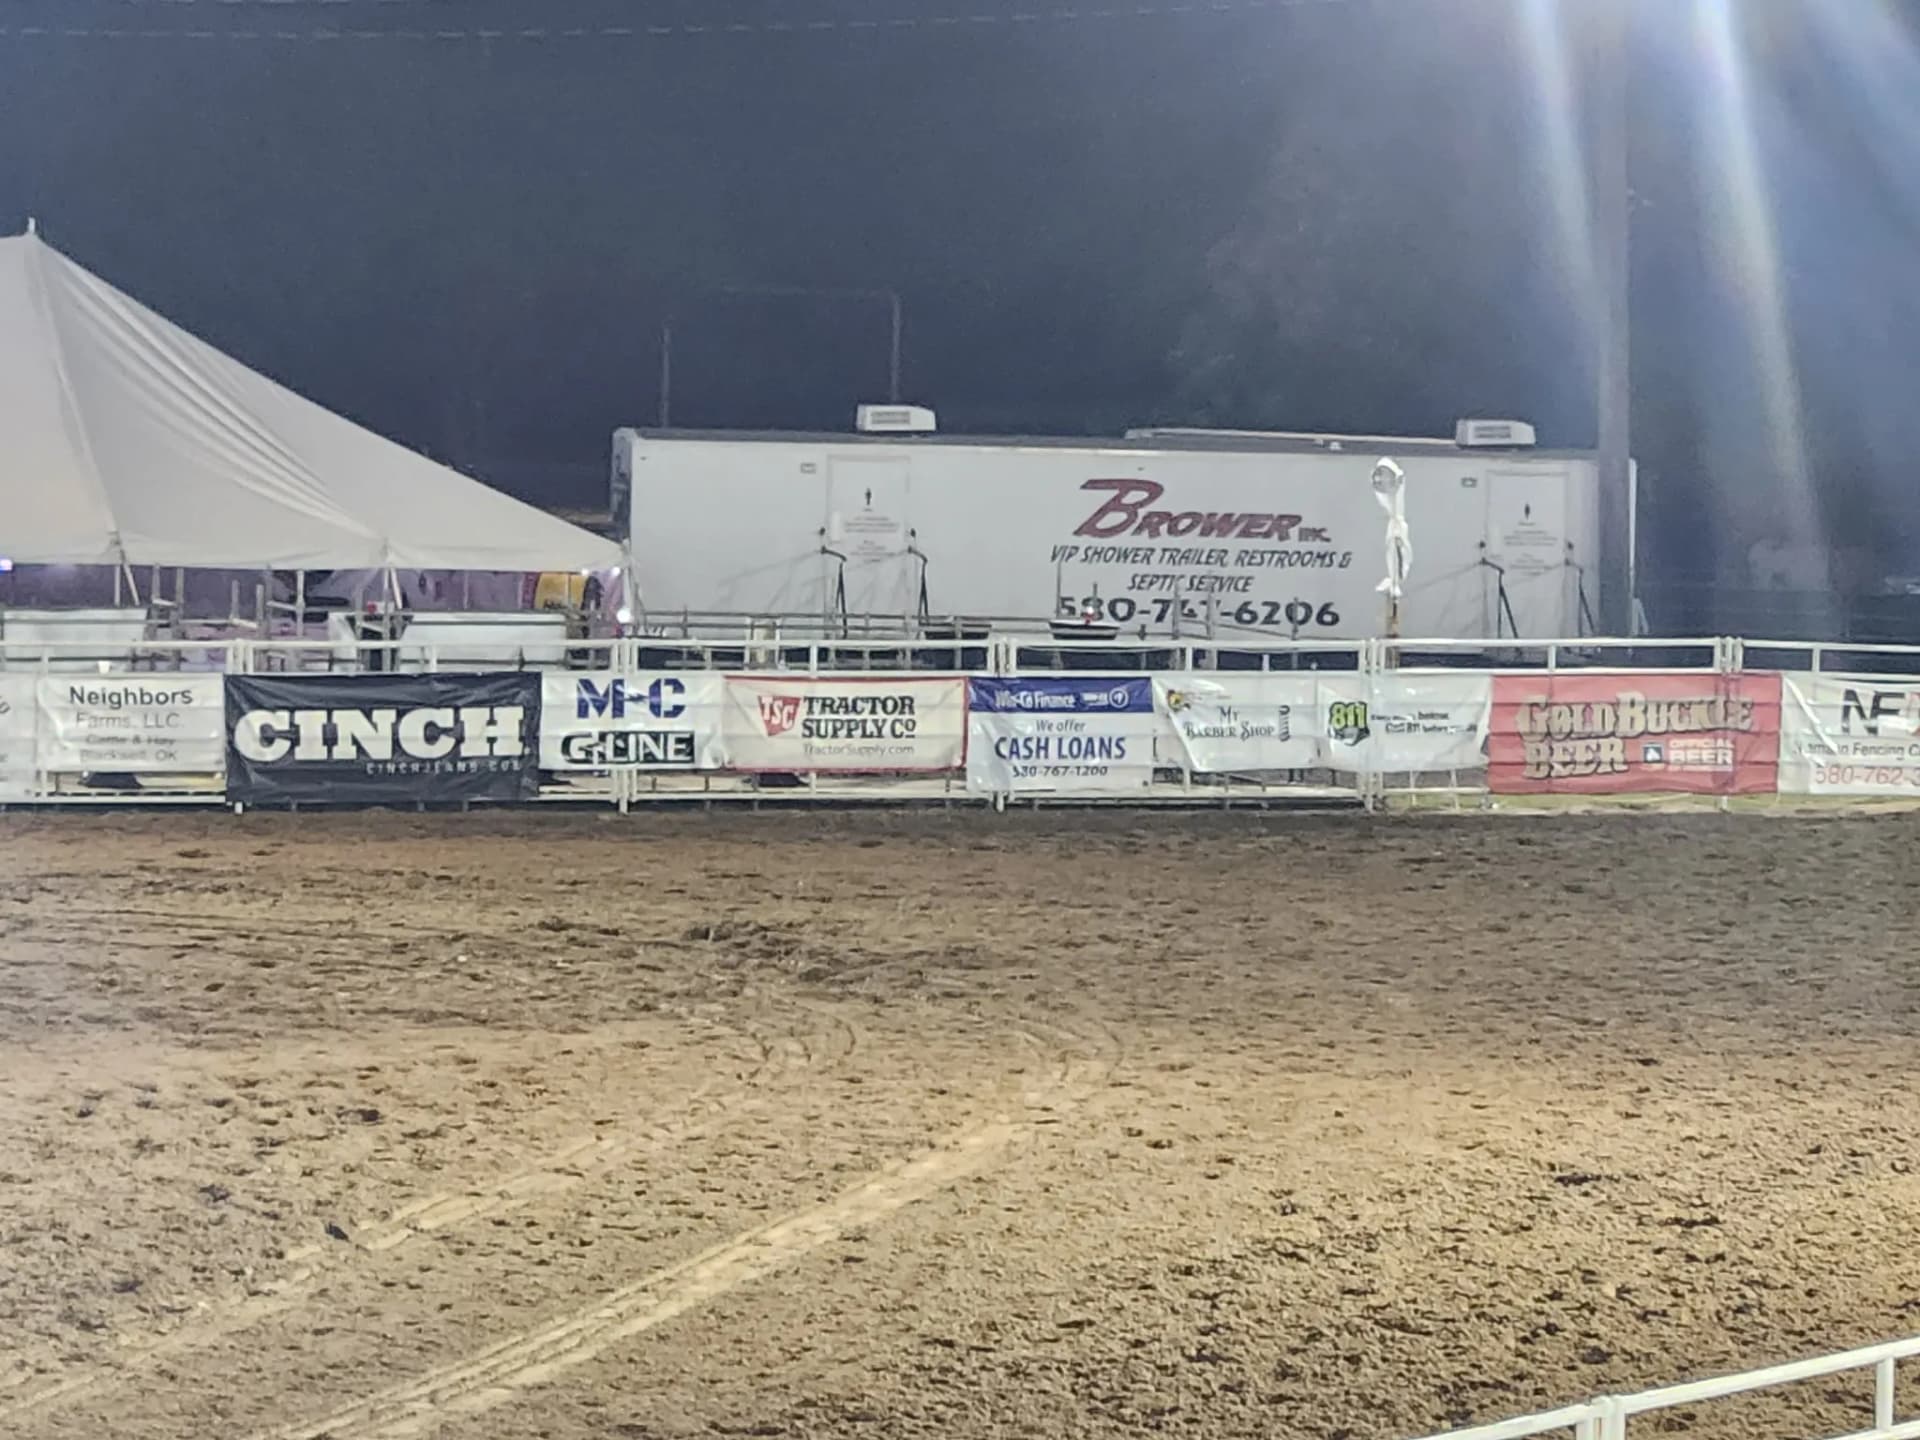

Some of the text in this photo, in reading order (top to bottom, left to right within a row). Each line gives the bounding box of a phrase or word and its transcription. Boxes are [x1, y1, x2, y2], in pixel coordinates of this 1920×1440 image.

[1073, 478, 1302, 541] BROWER
[1051, 545, 1079, 562] VIP
[1080, 546, 1156, 564] SHOWER
[1234, 549, 1336, 568] RESTROOMS
[1338, 551, 1352, 568] &
[1186, 575, 1255, 592] SERVICE
[70, 686, 193, 709] Neighbors
[803, 696, 915, 716] TRACTOR
[761, 696, 796, 730] TSC
[1331, 702, 1367, 729] 811
[234, 706, 524, 762] CINCH
[802, 718, 885, 739] SUPPLY
[1035, 720, 1086, 732] We offer
[994, 736, 1126, 761] CASH LOANS
[1521, 738, 1628, 779] BEER
[1669, 749, 1733, 764] BEER
